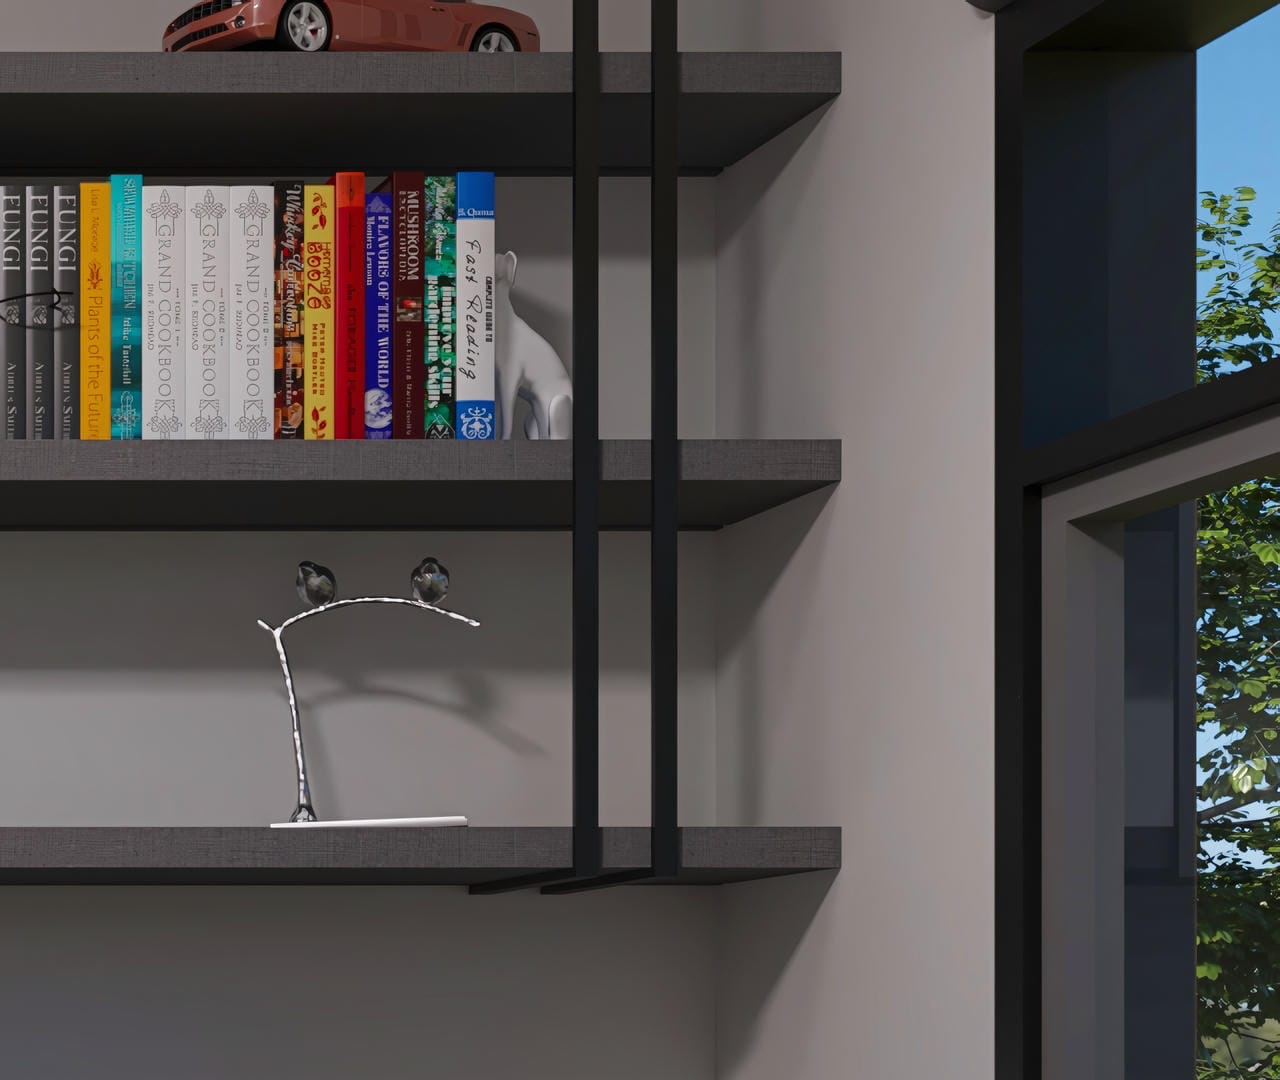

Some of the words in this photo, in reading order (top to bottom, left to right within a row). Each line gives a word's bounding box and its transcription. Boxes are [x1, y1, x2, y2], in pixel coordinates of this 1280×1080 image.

[2, 195, 20, 271] FUNGI
[30, 195, 48, 271] FUNGI
[58, 195, 76, 271] FUNGI
[281, 184, 303, 252] Whiskey
[378, 215, 389, 278] FLAVORS
[407, 191, 419, 280] MUSHROOM
[158, 224, 171, 293] GRAND
[202, 224, 216, 293] GRAND
[246, 224, 260, 293] GRAND
[378, 281, 389, 300] OF
[465, 240, 481, 283] Fast
[88, 296, 103, 340] Plants
[378, 302, 389, 333] THE
[458, 295, 482, 380] Reading
[88, 344, 103, 361] of
[88, 364, 103, 389] the
[158, 299, 172, 412] COOKBOOK
[202, 299, 216, 412] COOKBOOK
[246, 299, 260, 412] COOKBOOK
[378, 337, 389, 388] WORLD
[427, 365, 440, 408] skills
[88, 393, 103, 440] Futur
